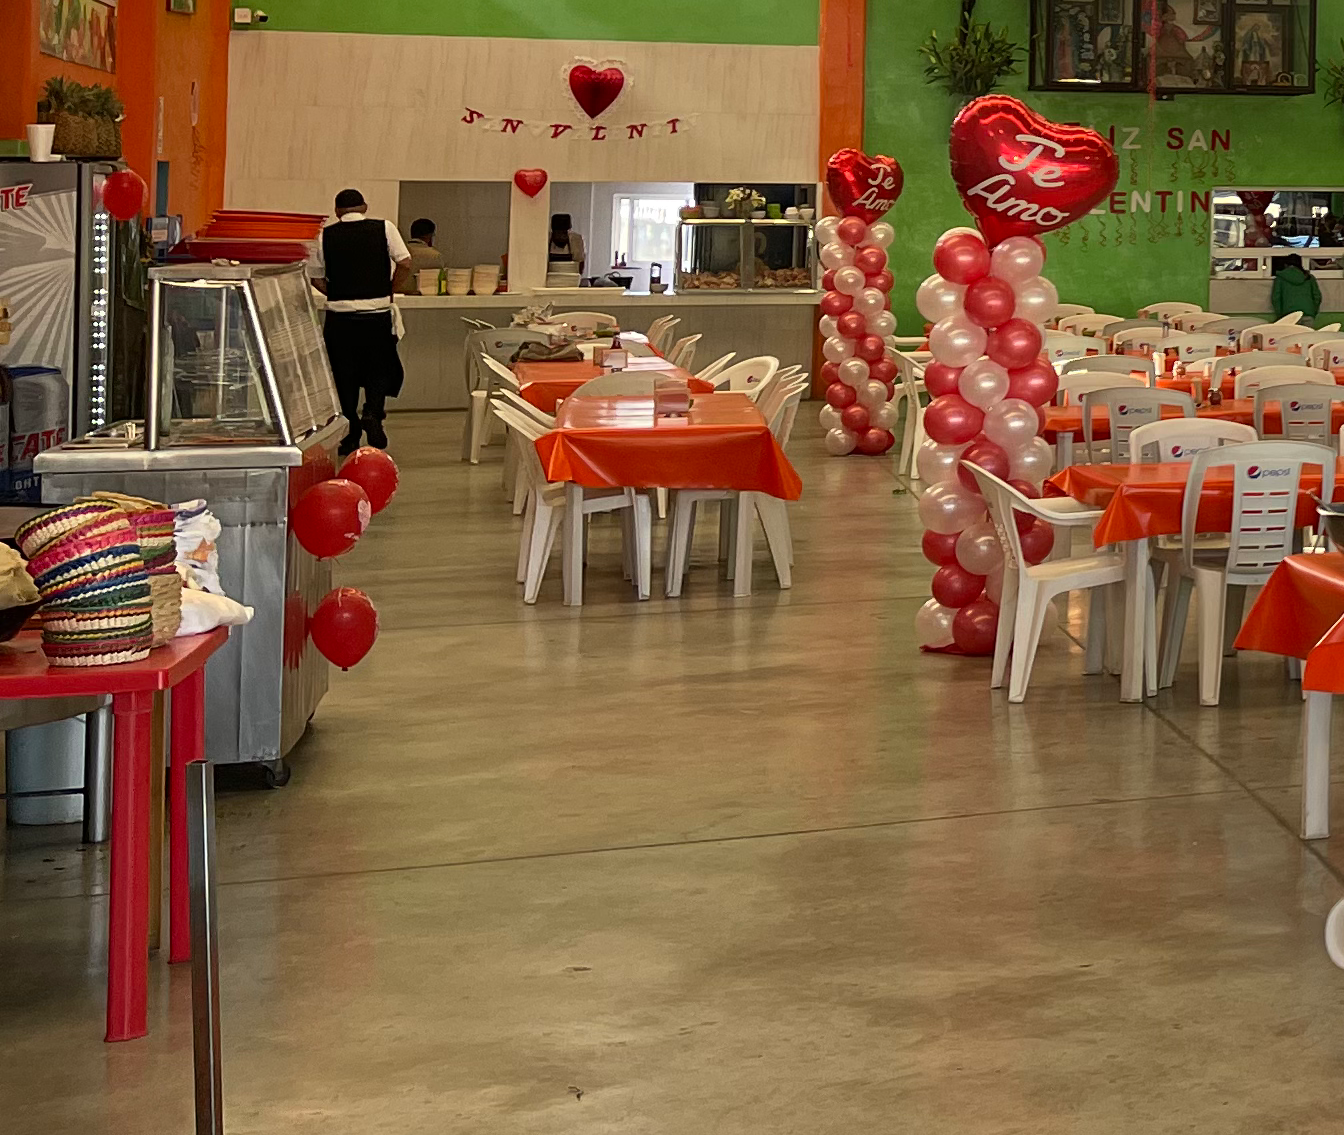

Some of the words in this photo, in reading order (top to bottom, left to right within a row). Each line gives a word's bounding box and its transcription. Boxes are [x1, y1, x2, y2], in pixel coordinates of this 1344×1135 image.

[1166, 126, 1231, 151] SAN
[998, 134, 1067, 187] Te
[868, 163, 896, 190] Te
[859, 187, 894, 211] Amo
[967, 176, 1070, 227] Amo
[1263, 468, 1290, 479] pepsi
